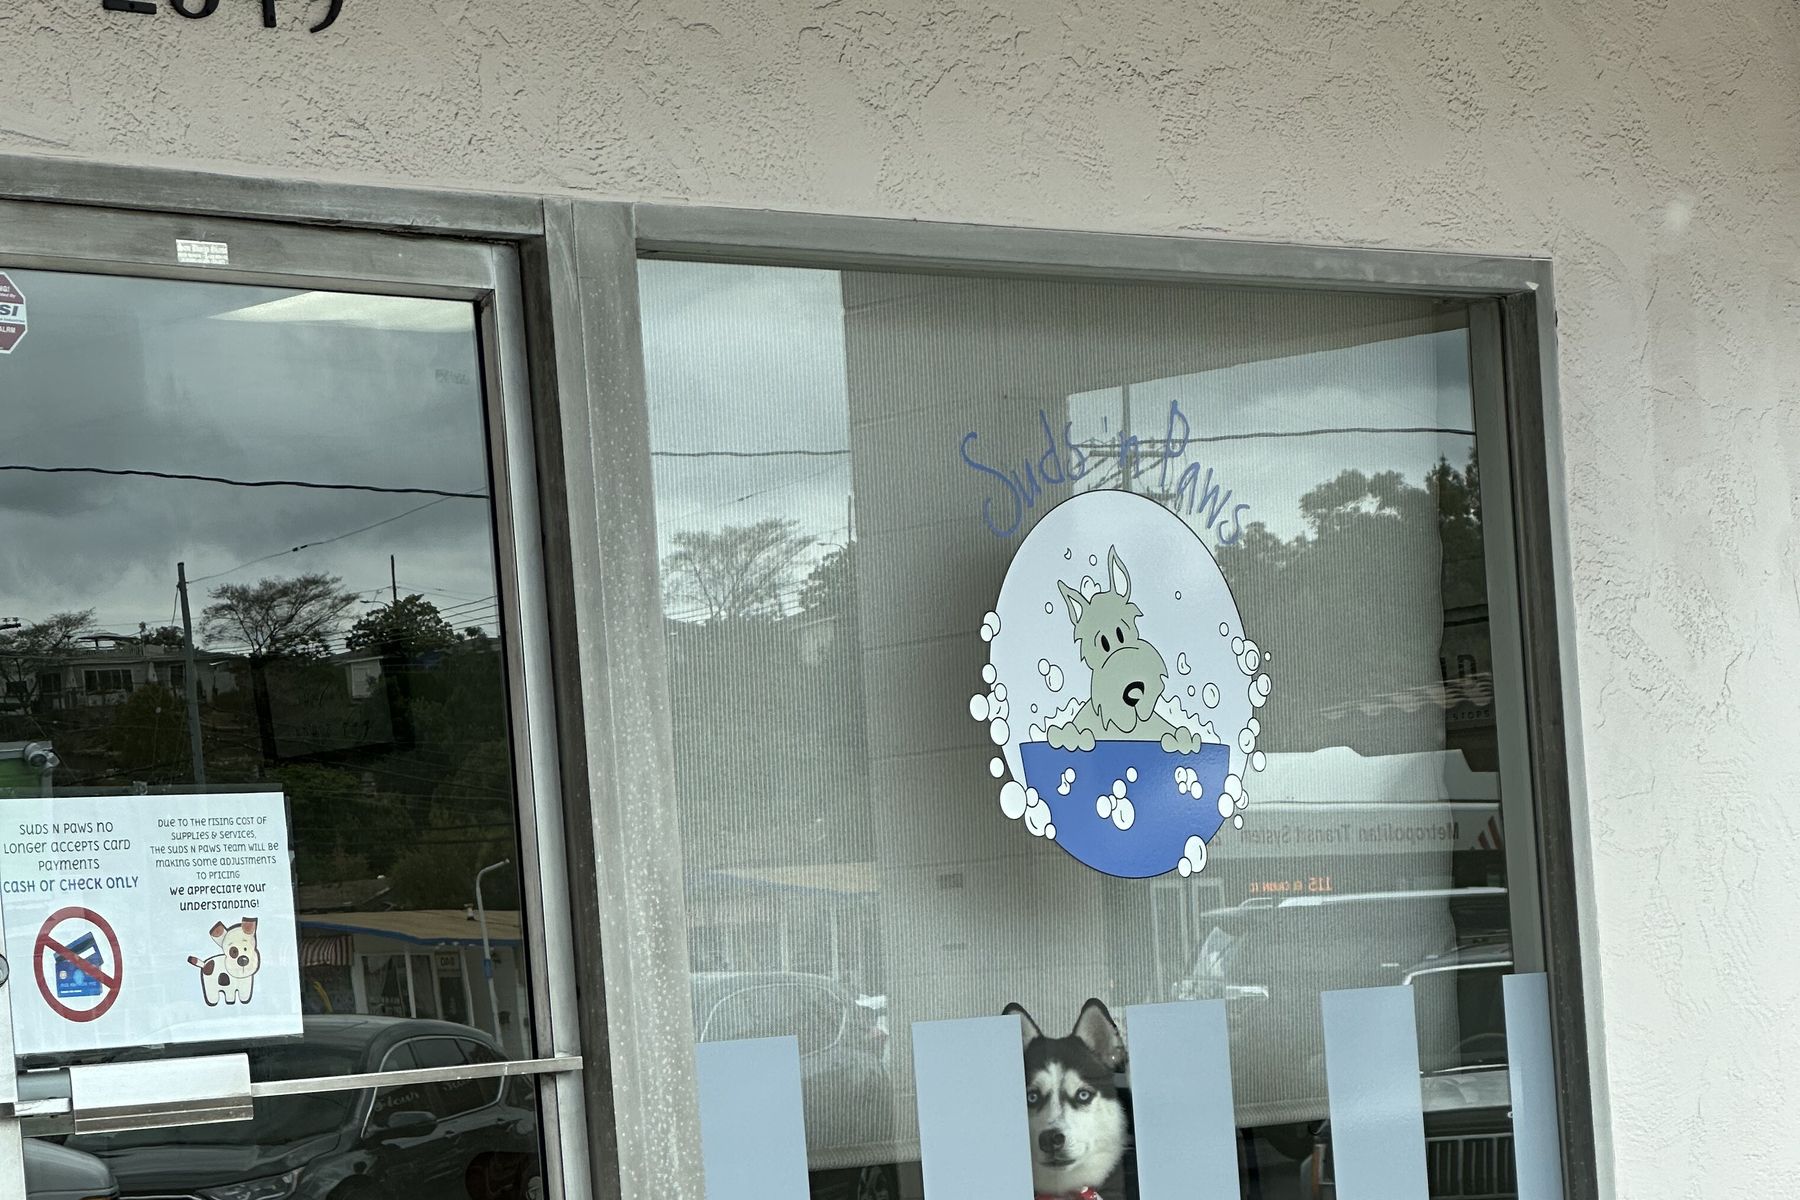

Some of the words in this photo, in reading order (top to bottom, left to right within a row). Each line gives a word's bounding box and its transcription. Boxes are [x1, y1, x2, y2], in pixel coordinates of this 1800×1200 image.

[960, 408, 1085, 538] Suds
[1160, 400, 1250, 545] Paws
[52, 823, 60, 834] N
[190, 845, 196, 853] N
